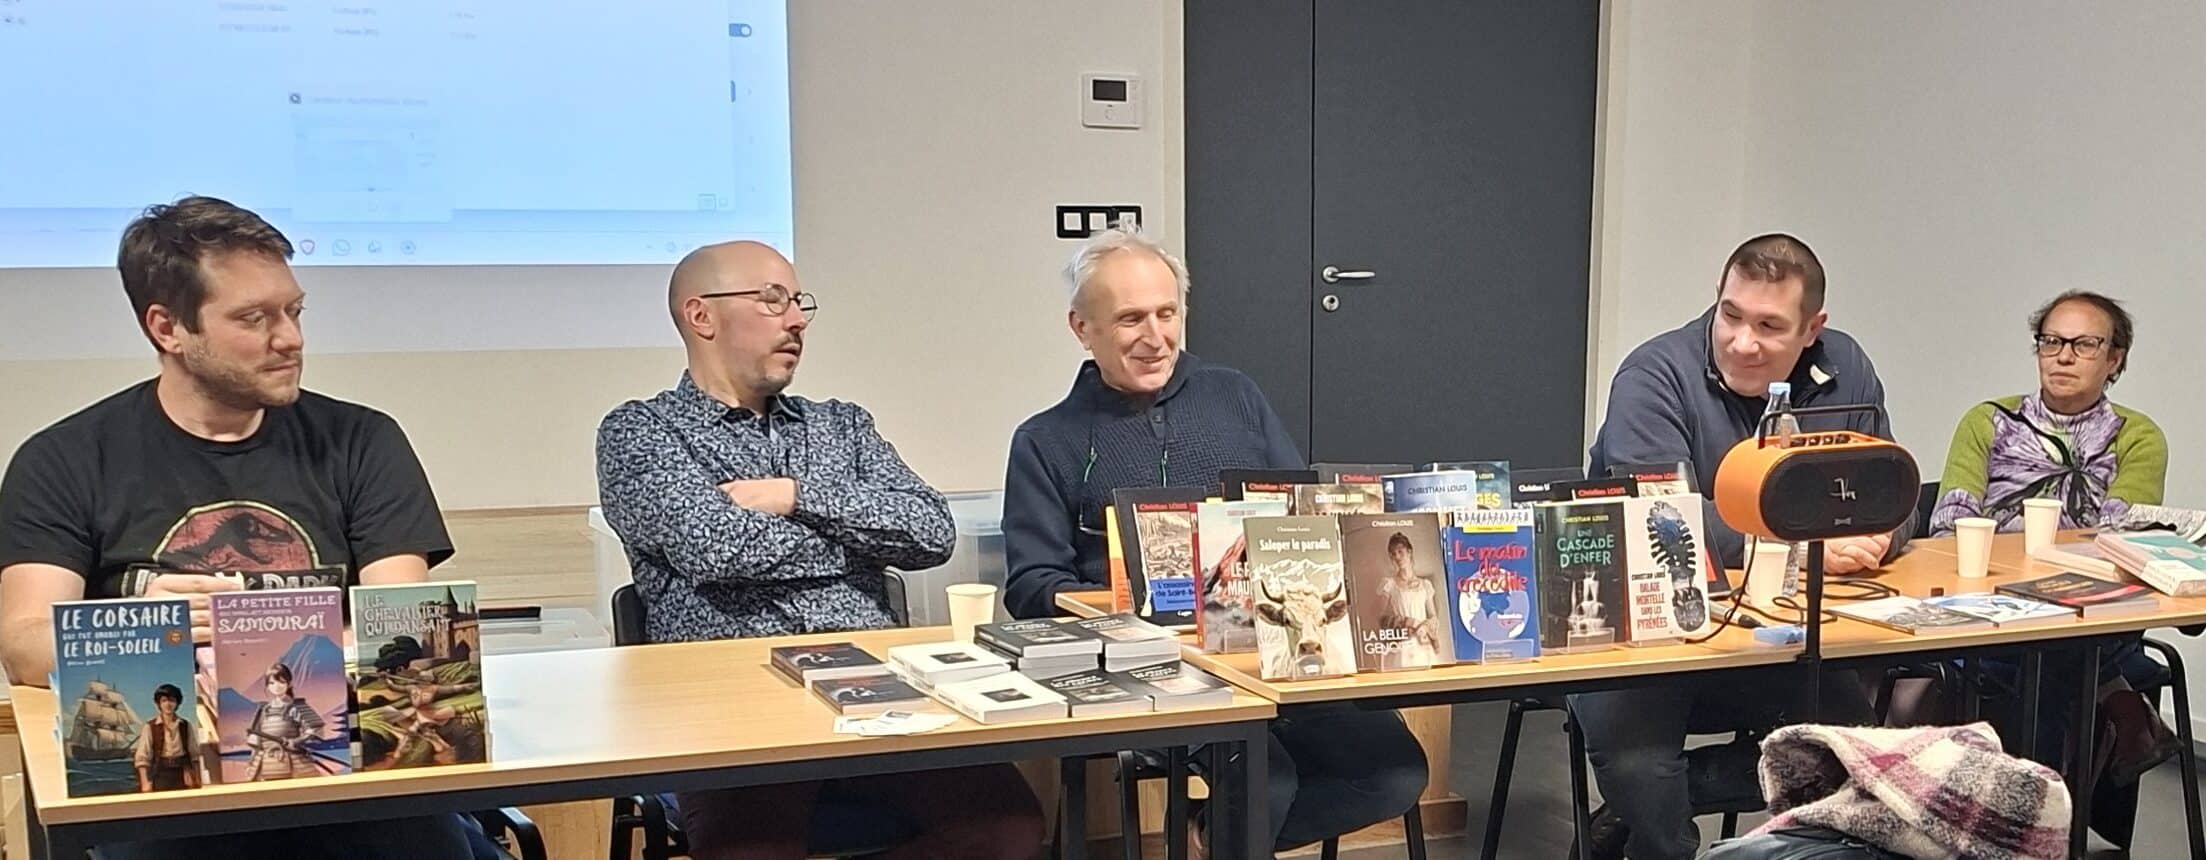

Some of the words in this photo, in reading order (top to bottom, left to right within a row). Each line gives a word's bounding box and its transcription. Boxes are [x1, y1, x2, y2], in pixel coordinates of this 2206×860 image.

[1407, 487, 1445, 495] CHRISTIAN
[1447, 484, 1468, 492] LOUIS
[1301, 538, 1331, 552] paradis
[1454, 540, 1476, 561] Le
[1556, 534, 1615, 552] CASCADE
[1560, 551, 1612, 568] D'ENFER
[1227, 580, 1252, 596] MAU
[1457, 571, 1529, 592] crocodile
[217, 598, 237, 609] LA
[241, 597, 292, 609] PETITE
[294, 595, 337, 606] FILLE
[364, 594, 384, 608] LE
[1636, 593, 1665, 605] MORTELLE
[61, 608, 83, 631] LE
[92, 604, 183, 629] CORSAIRE
[364, 605, 443, 622] CHEVALIER
[218, 612, 326, 633] SAMOURAÏ
[365, 622, 389, 638] QUI
[390, 618, 452, 634] DANSAIT
[1363, 630, 1378, 641] LA
[1379, 628, 1409, 641] BELLE
[63, 641, 80, 658] LE
[85, 638, 161, 656] ROI-SOLEIL
